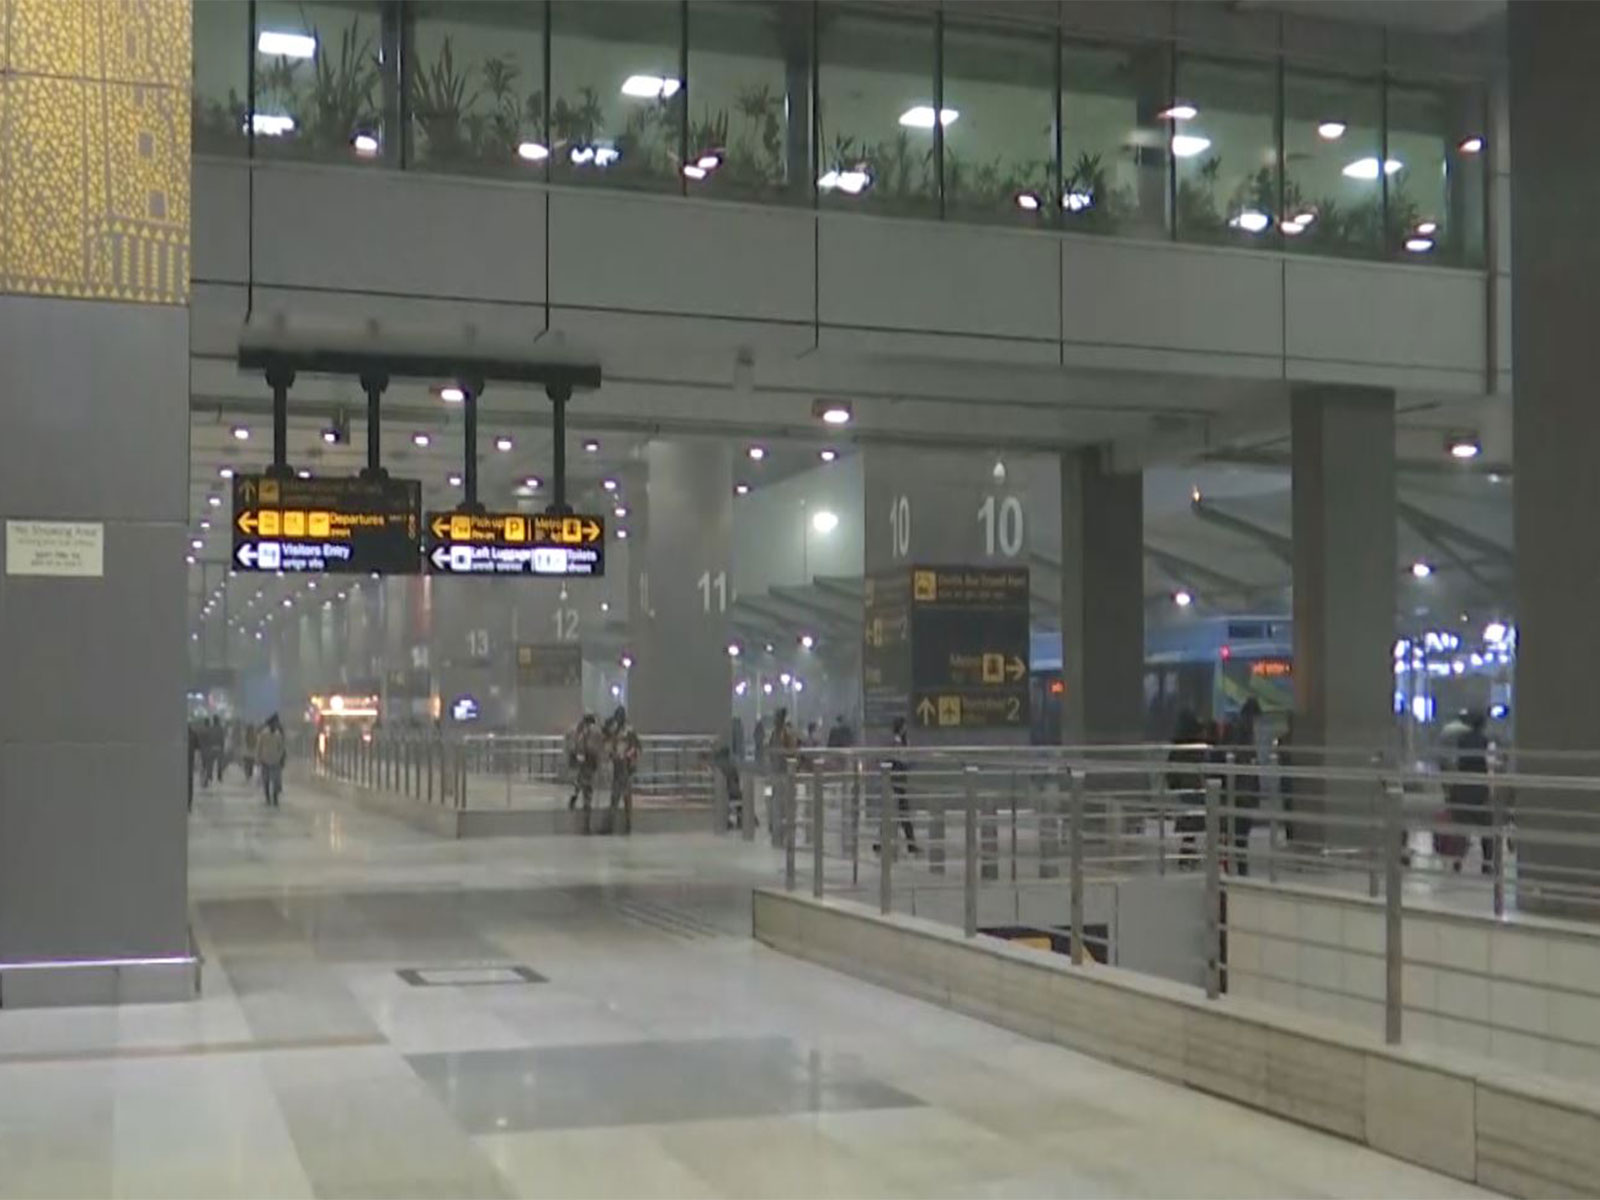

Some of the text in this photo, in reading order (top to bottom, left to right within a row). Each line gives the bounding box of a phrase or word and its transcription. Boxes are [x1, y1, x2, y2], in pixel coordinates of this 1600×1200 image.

[330, 512, 385, 526] Departures
[889, 496, 910, 558] 10
[977, 496, 1024, 557] 10
[281, 543, 350, 559] Visitors Entry
[472, 546, 490, 559] Left
[698, 570, 726, 613] 11
[553, 608, 579, 640] 12
[465, 630, 488, 656] 13
[1007, 697, 1021, 721] 2
